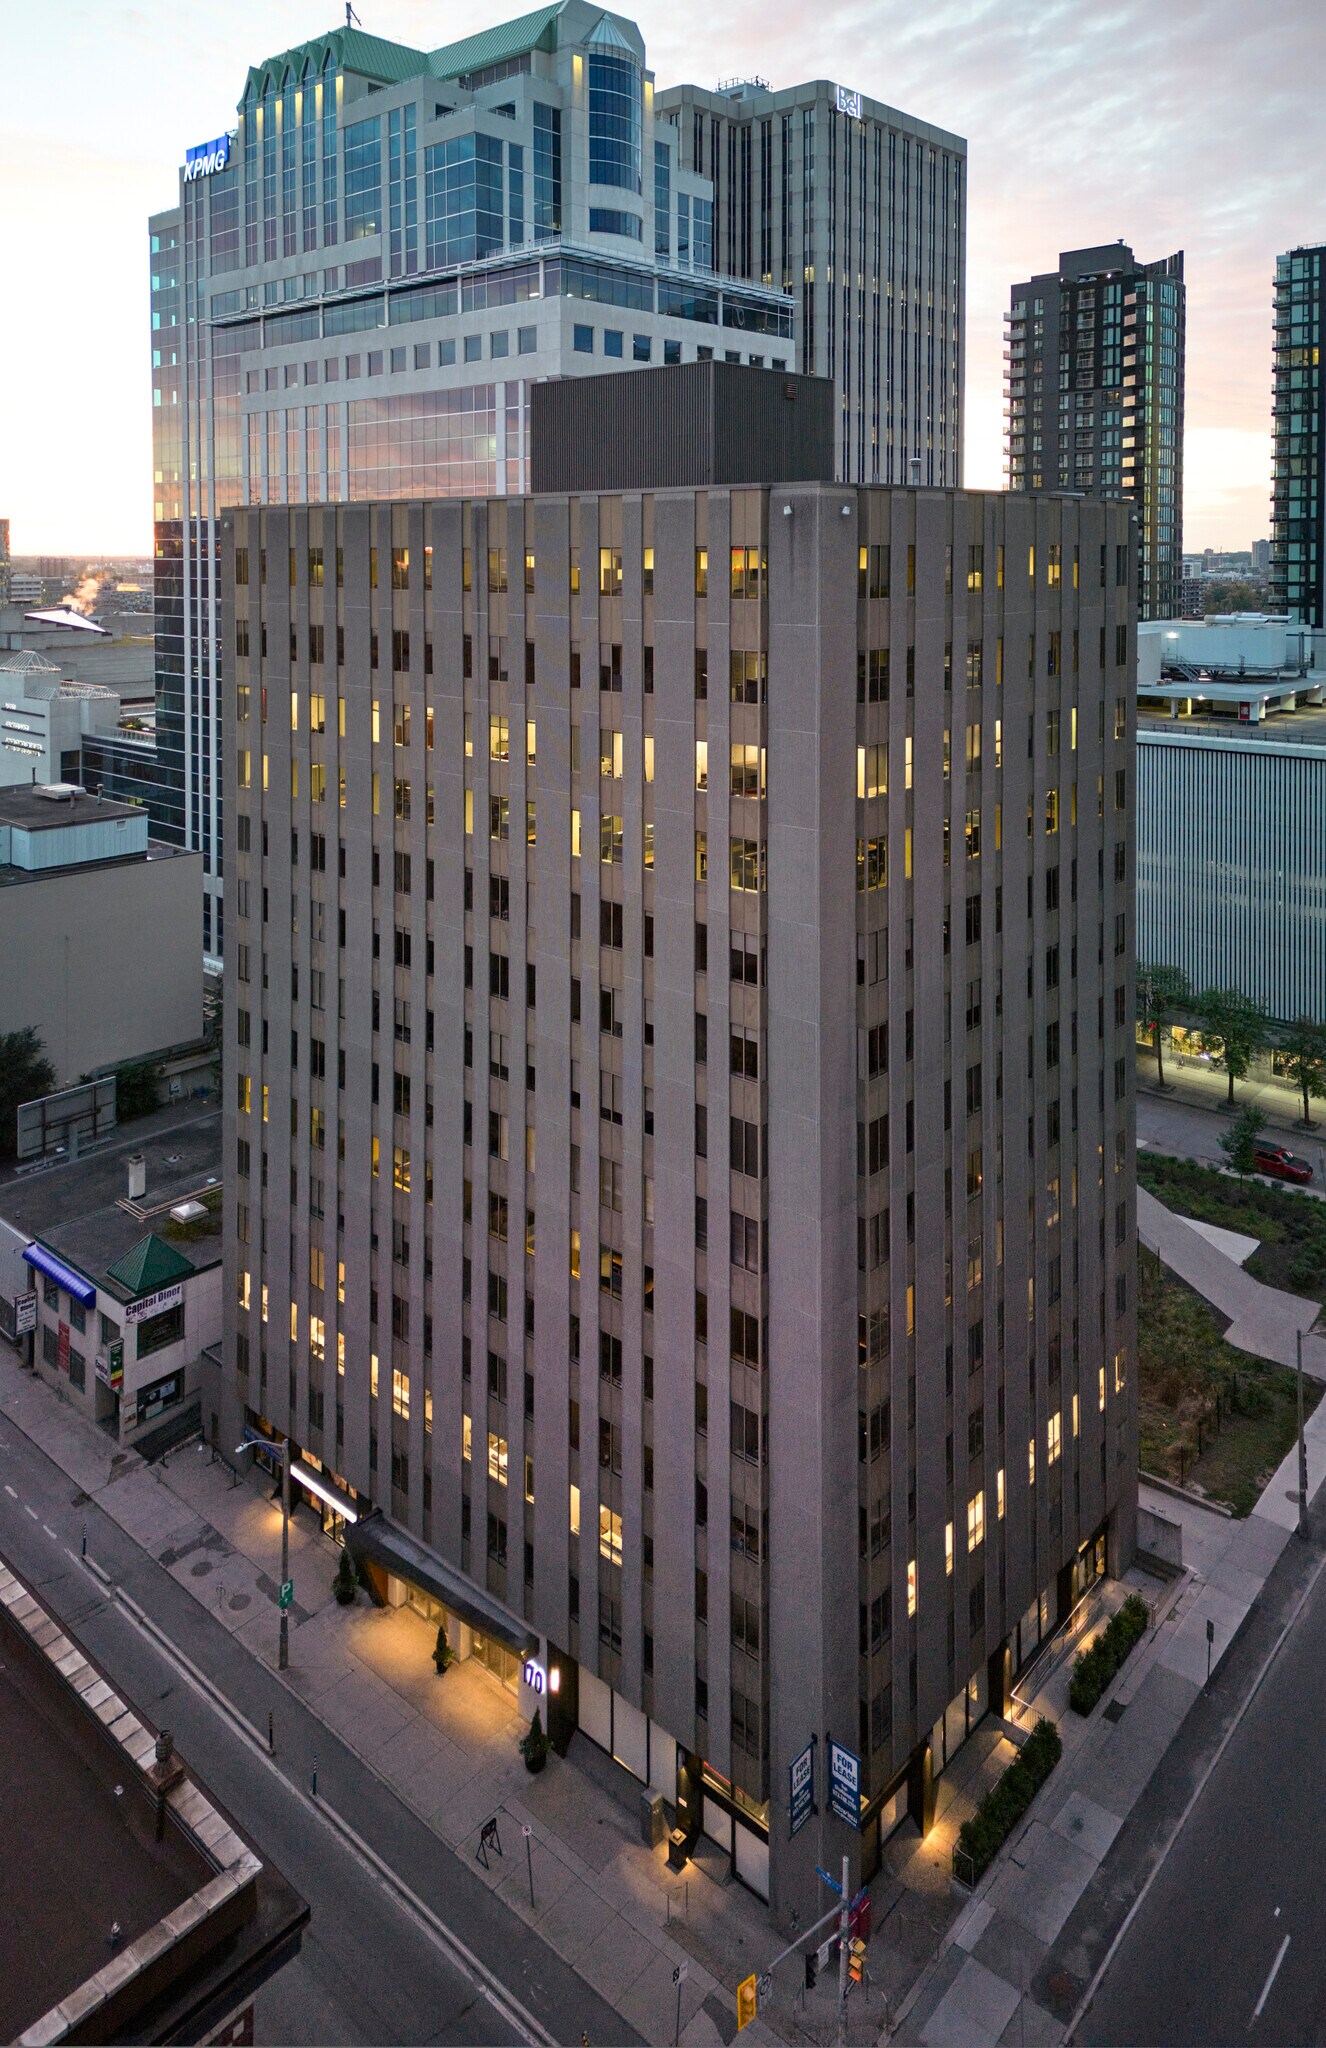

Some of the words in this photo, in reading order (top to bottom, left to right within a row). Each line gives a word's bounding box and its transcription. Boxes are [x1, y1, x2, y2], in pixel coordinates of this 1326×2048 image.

[836, 85, 861, 119] Bell
[184, 150, 225, 182] KPMG
[126, 1295, 157, 1316] Capital
[158, 1286, 180, 1302] Diner
[281, 1583, 291, 1598] P
[522, 1661, 543, 1694] 170
[796, 1757, 808, 1777] FOR
[833, 1762, 857, 1787] LEASE
[837, 1753, 853, 1772] FOR
[794, 1765, 810, 1790] LEASE
